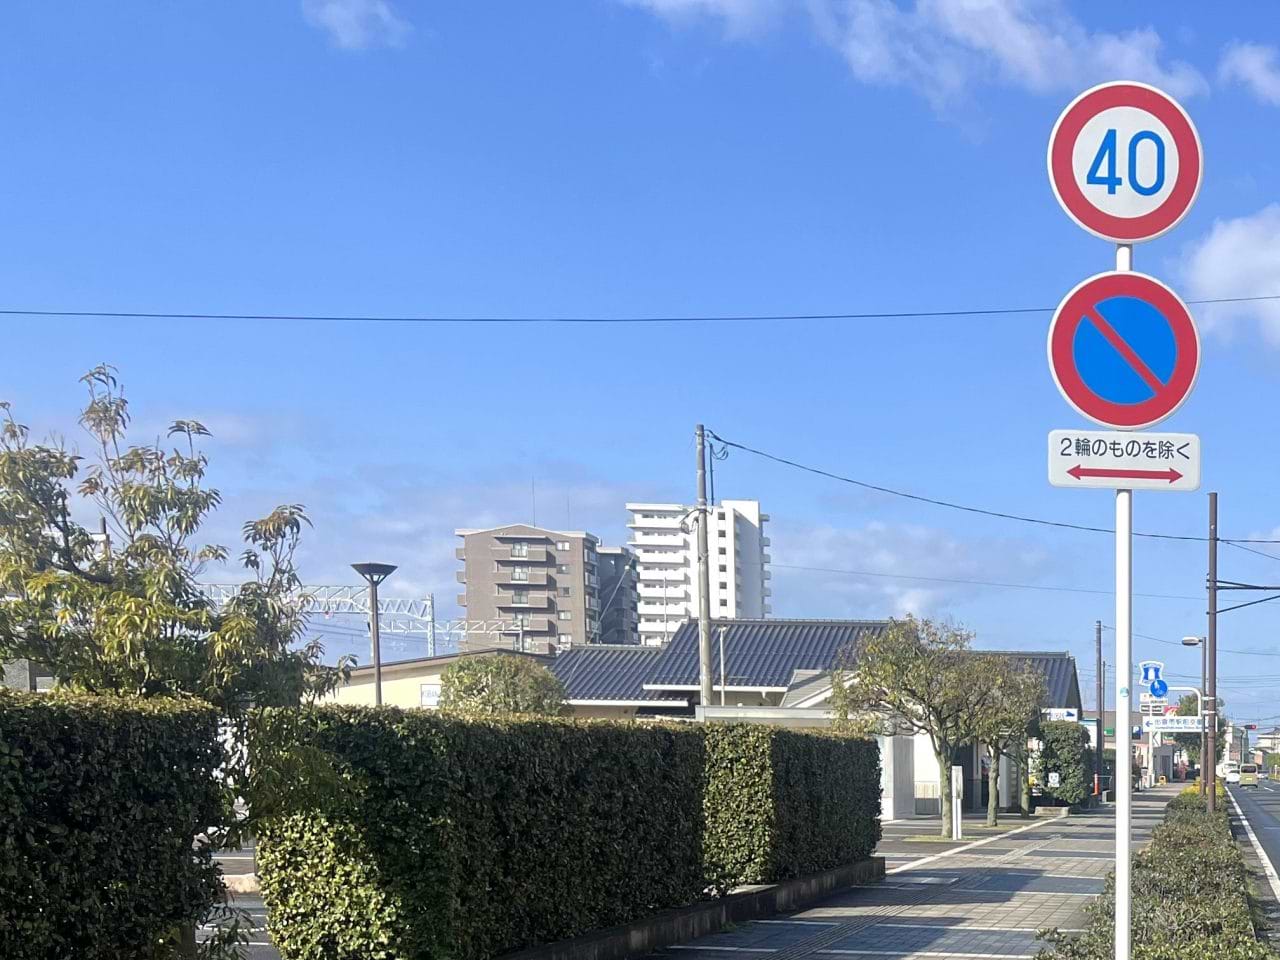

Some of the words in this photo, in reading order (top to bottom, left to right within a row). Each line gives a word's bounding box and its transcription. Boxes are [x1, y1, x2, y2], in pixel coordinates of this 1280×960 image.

[1086, 128, 1166, 197] 40
[1060, 437, 1191, 460] 2輪のものを除く
